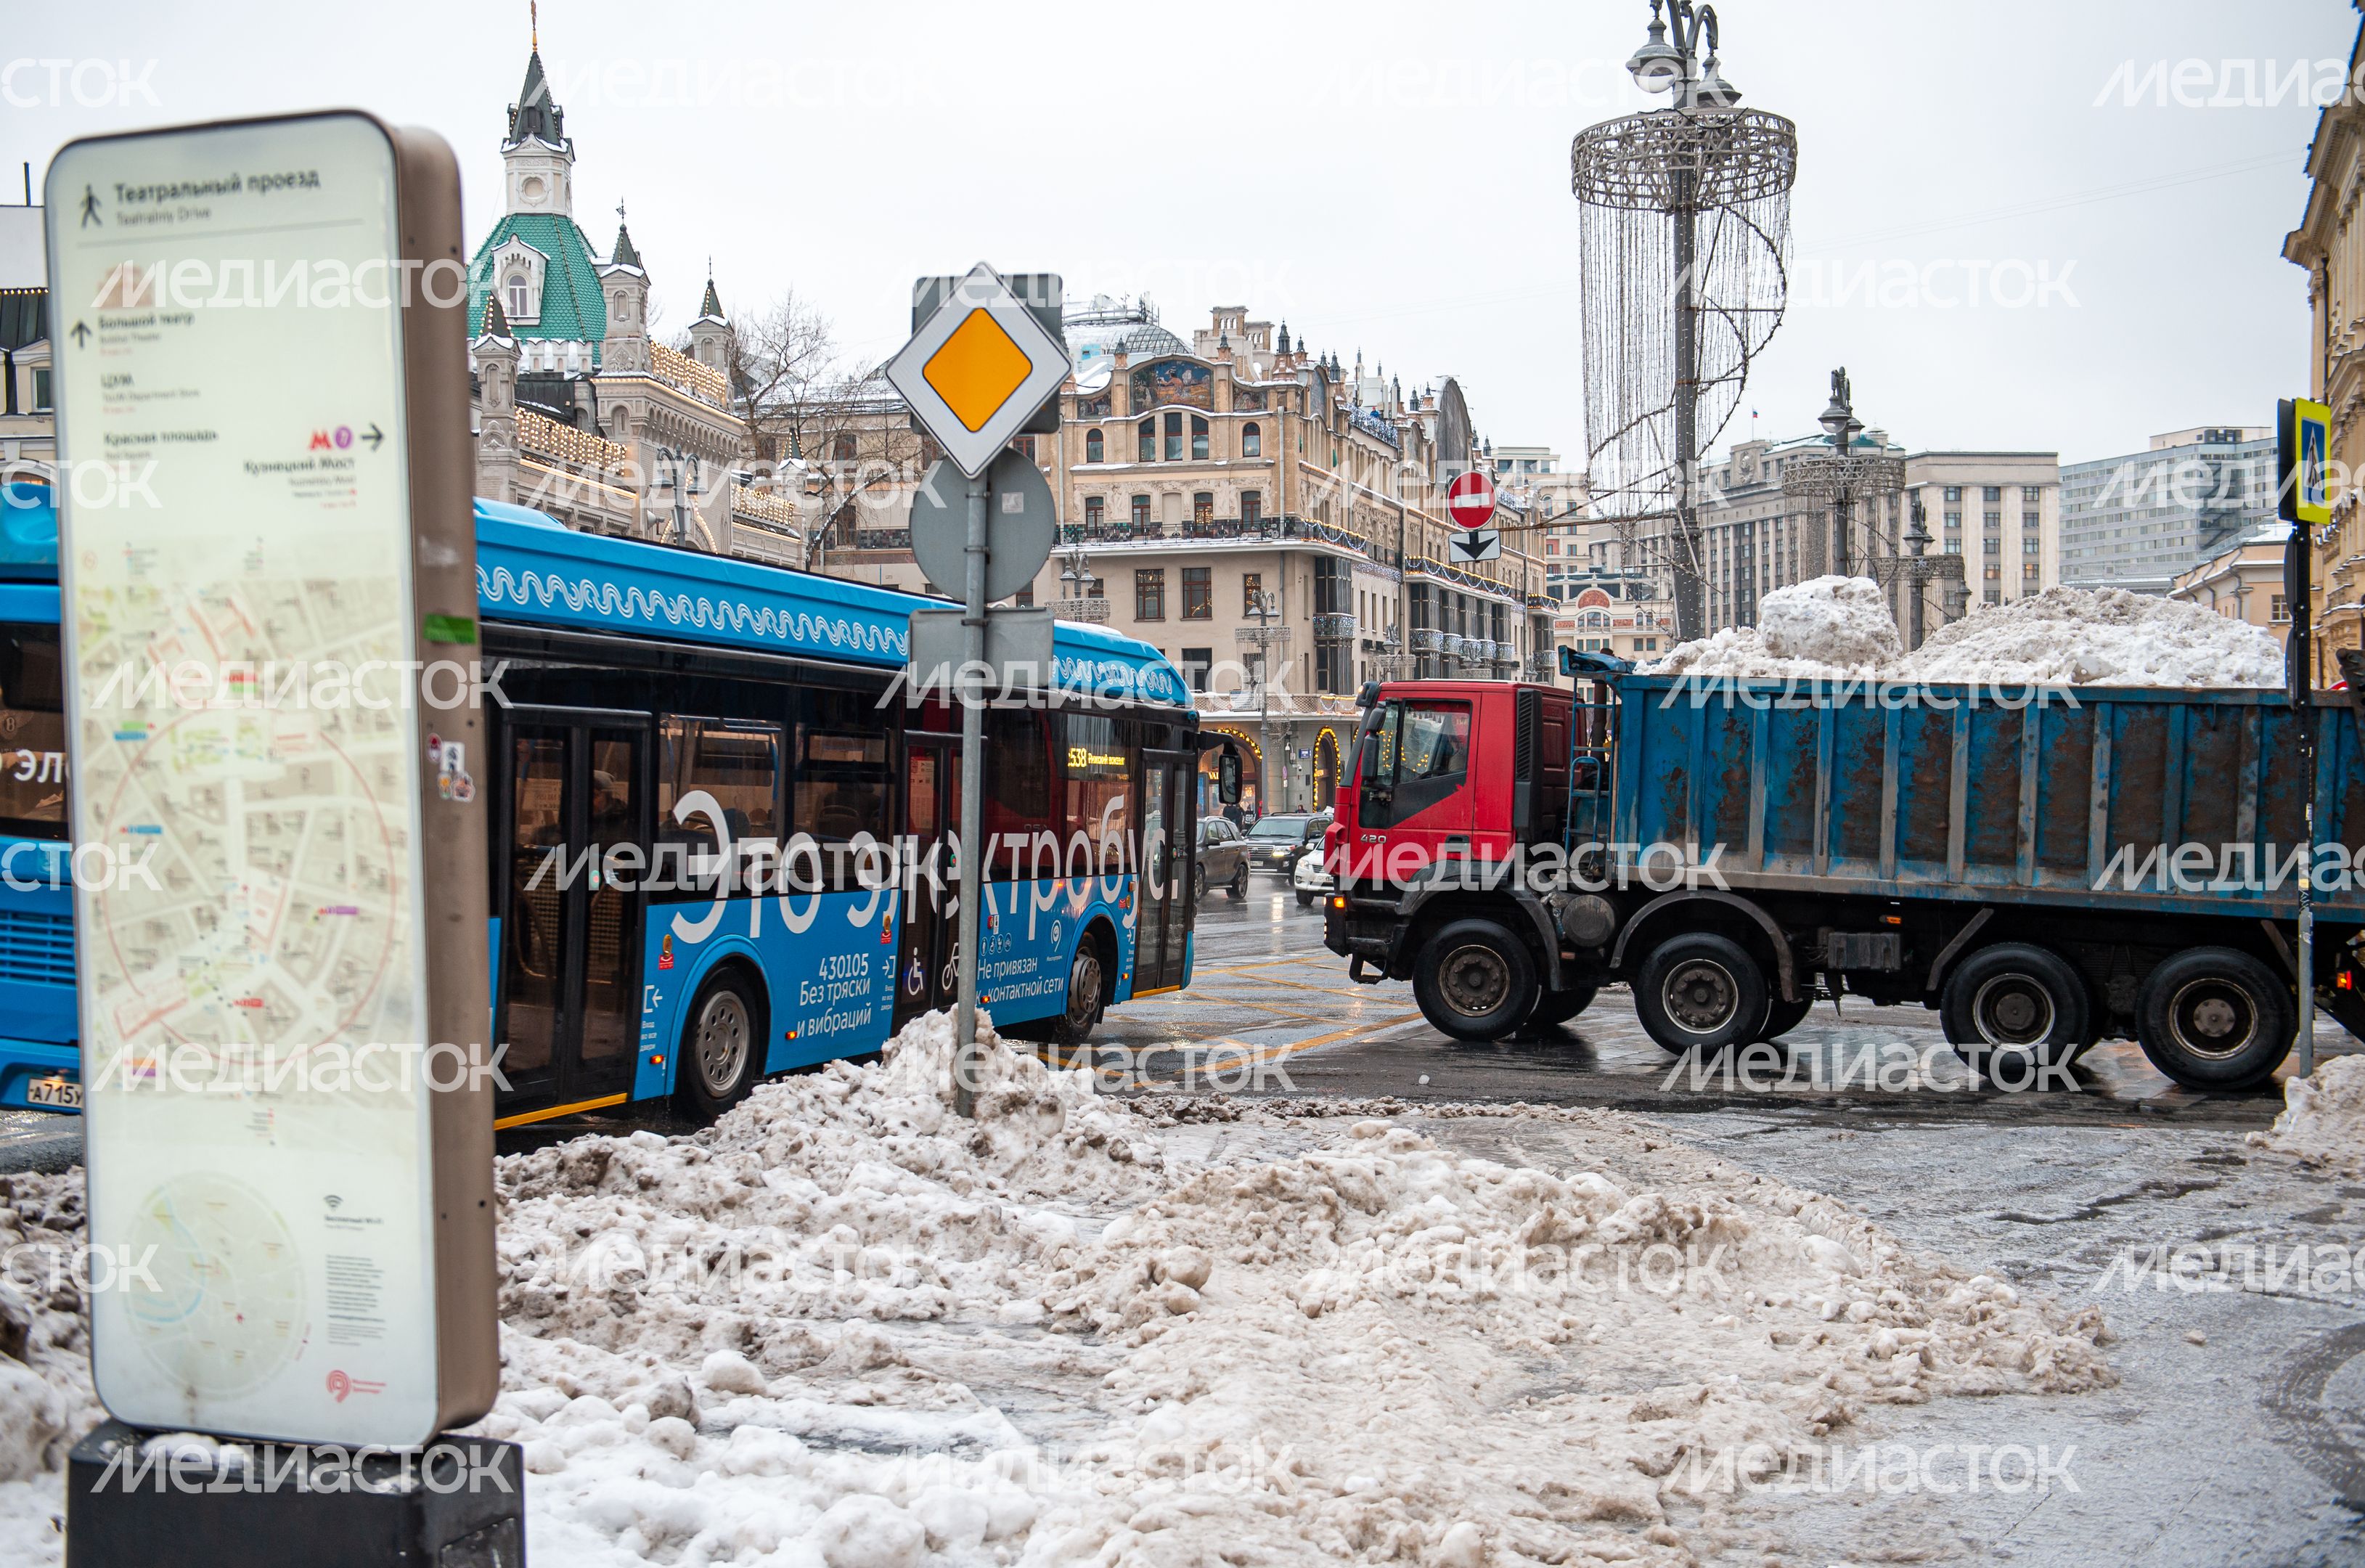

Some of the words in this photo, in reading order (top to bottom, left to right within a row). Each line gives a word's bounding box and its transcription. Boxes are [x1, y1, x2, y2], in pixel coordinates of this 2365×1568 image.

[115, 173, 242, 204] Театральный
[247, 169, 321, 193] проезд
[244, 459, 316, 476] Кузнецкий
[15, 748, 70, 783] эл
[1360, 834, 1386, 844] 420
[671, 790, 823, 943] Это
[819, 953, 869, 981] 430105
[977, 959, 992, 980] Не
[993, 957, 1038, 980] привязан
[800, 981, 825, 1006] Без
[827, 978, 870, 1006] тряски
[988, 976, 1043, 1003] контактной
[1043, 977, 1064, 994] сети
[796, 1020, 806, 1039] и
[807, 1002, 872, 1037] вибраций
